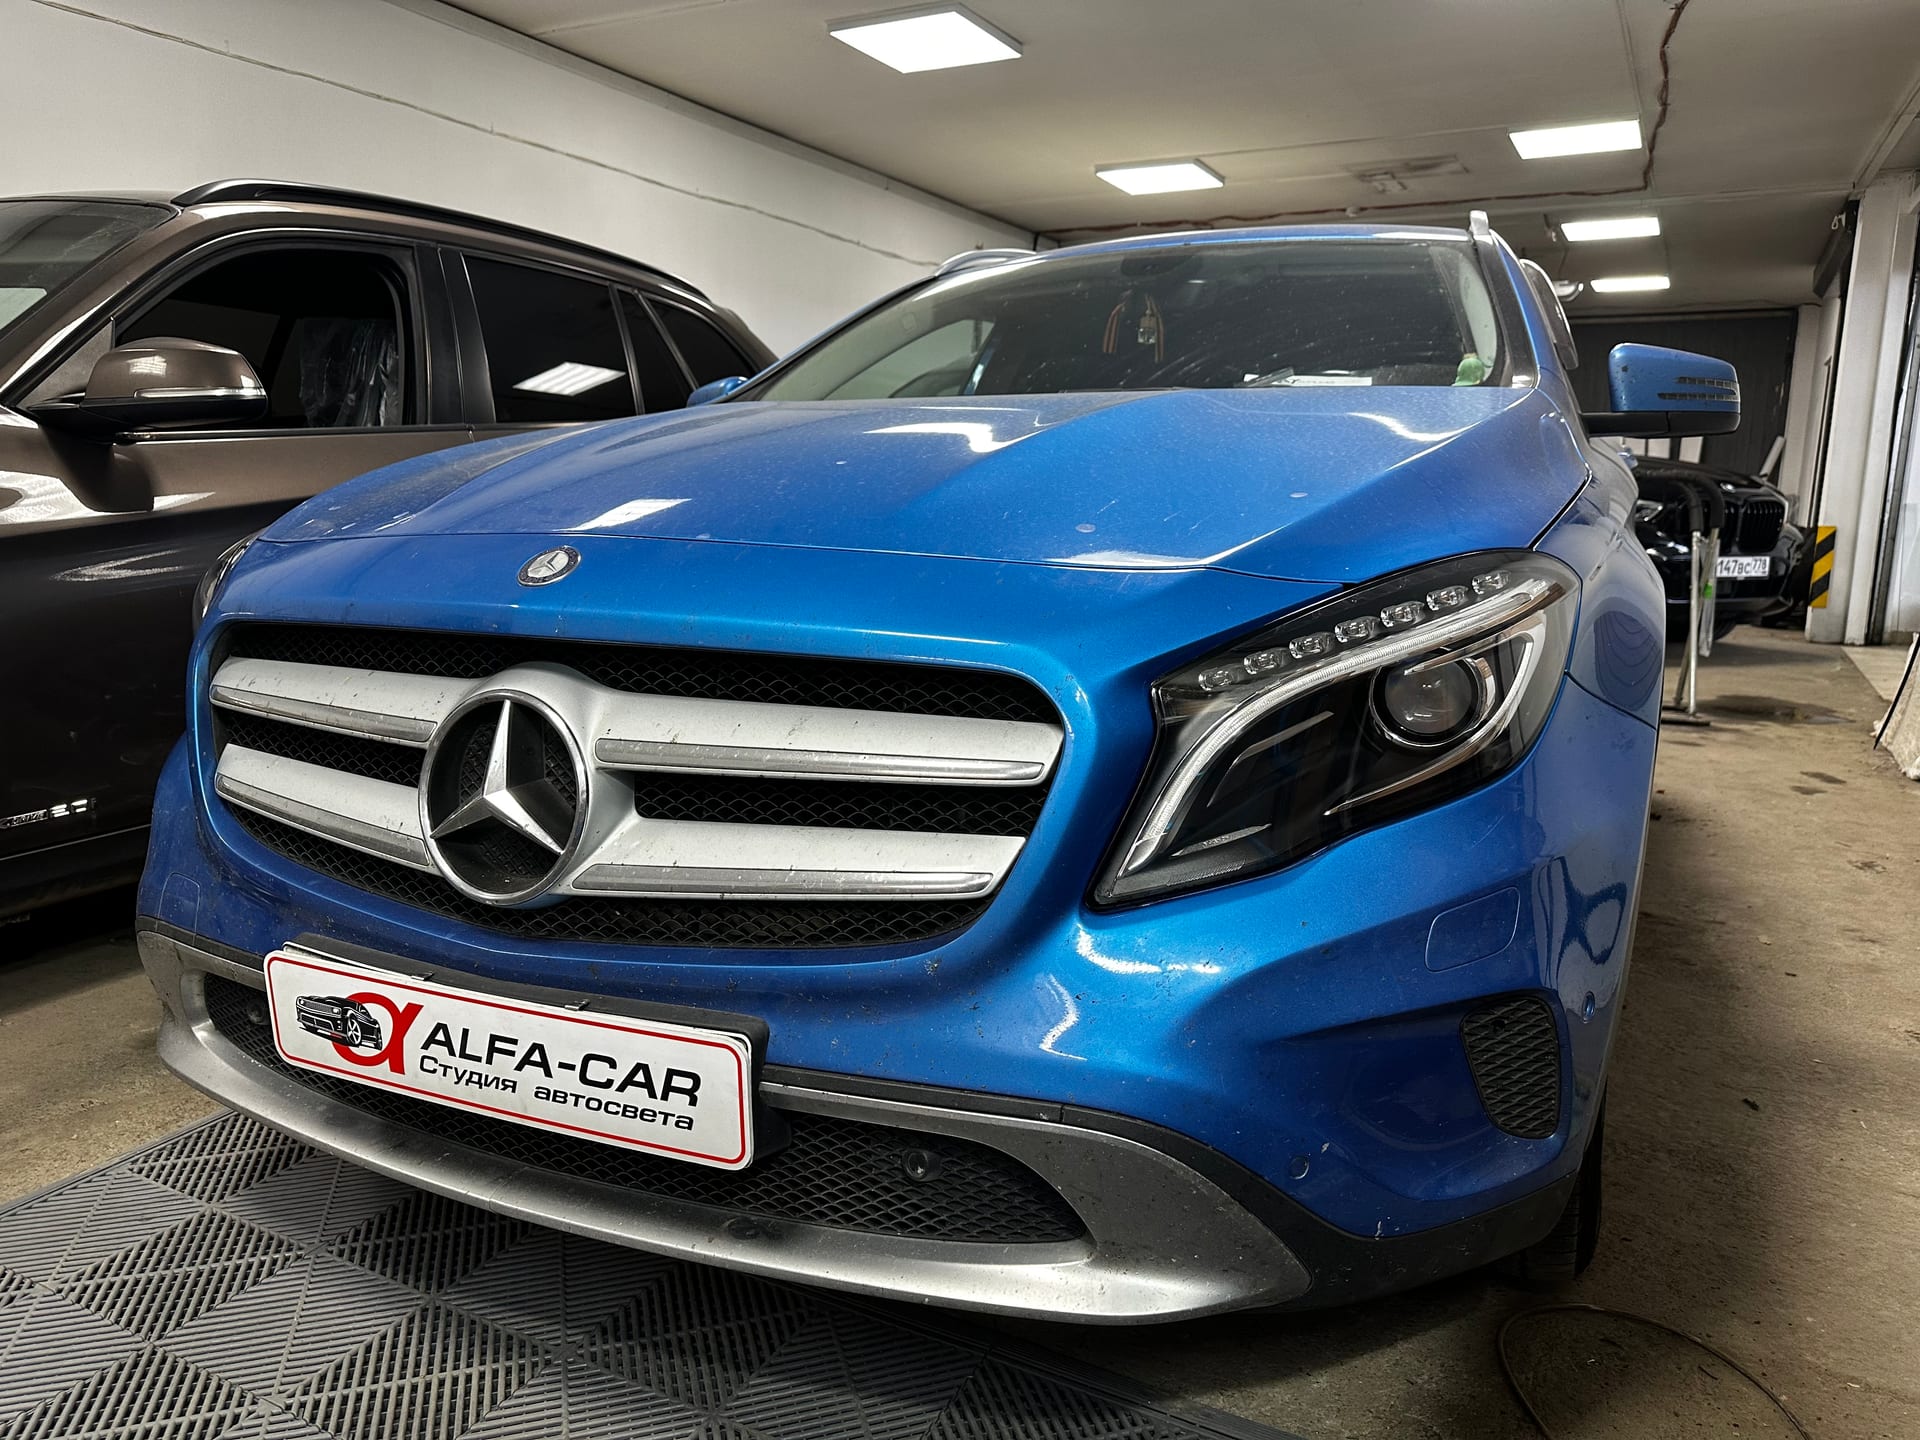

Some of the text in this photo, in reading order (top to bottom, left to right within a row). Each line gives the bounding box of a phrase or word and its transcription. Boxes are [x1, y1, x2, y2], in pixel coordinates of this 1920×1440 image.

[1718, 559, 1751, 575] 147BC
[419, 1055, 694, 1131] Студия автосвета
[420, 1022, 702, 1108] ALFA-CAR
